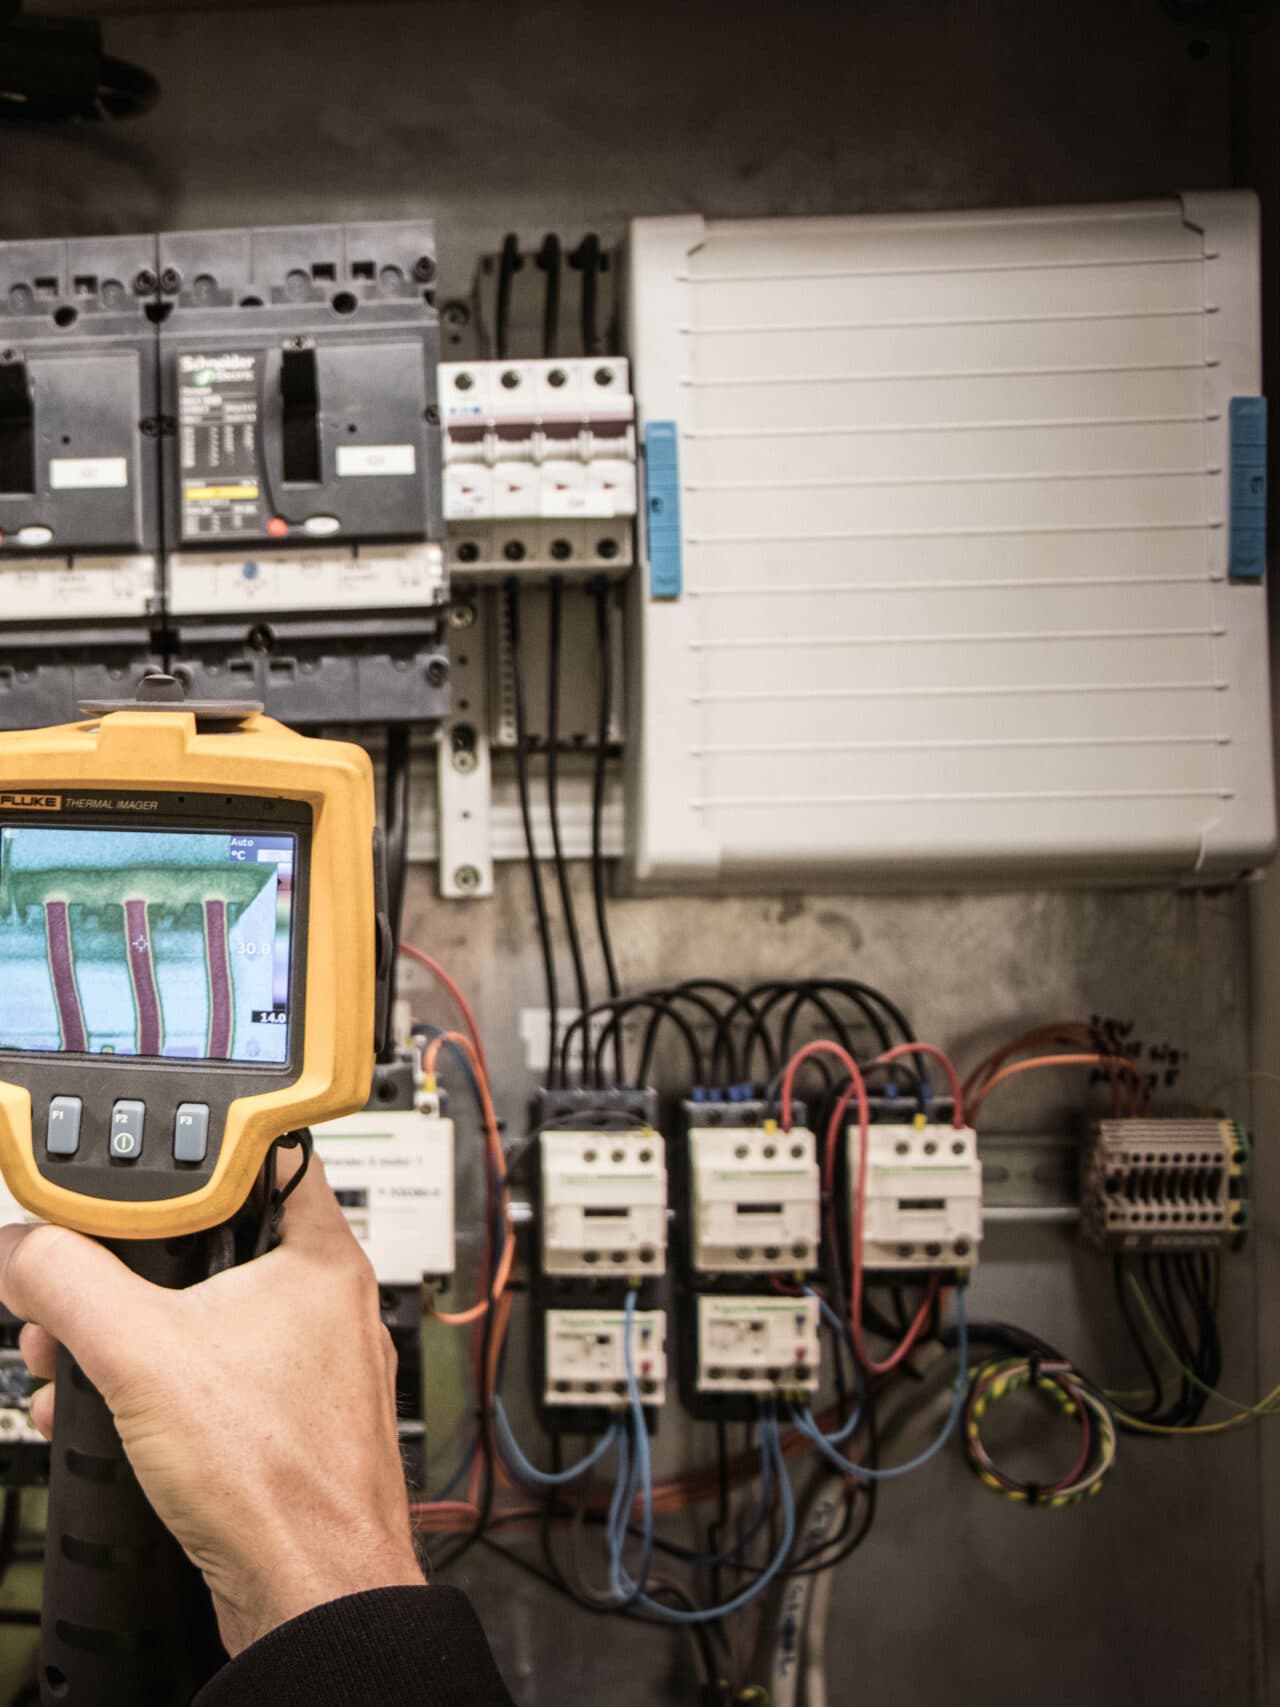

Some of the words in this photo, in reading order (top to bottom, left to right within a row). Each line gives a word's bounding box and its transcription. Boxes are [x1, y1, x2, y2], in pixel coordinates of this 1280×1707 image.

[0, 796, 57, 808] FLUKE
[65, 799, 113, 809] THERMAL
[117, 800, 158, 810] IMAGER
[231, 838, 254, 847] Auto
[231, 850, 246, 861] °C
[260, 1012, 287, 1024] 14.0
[52, 1111, 64, 1120] F1
[115, 1114, 128, 1123] F2
[180, 1116, 192, 1125] F3
